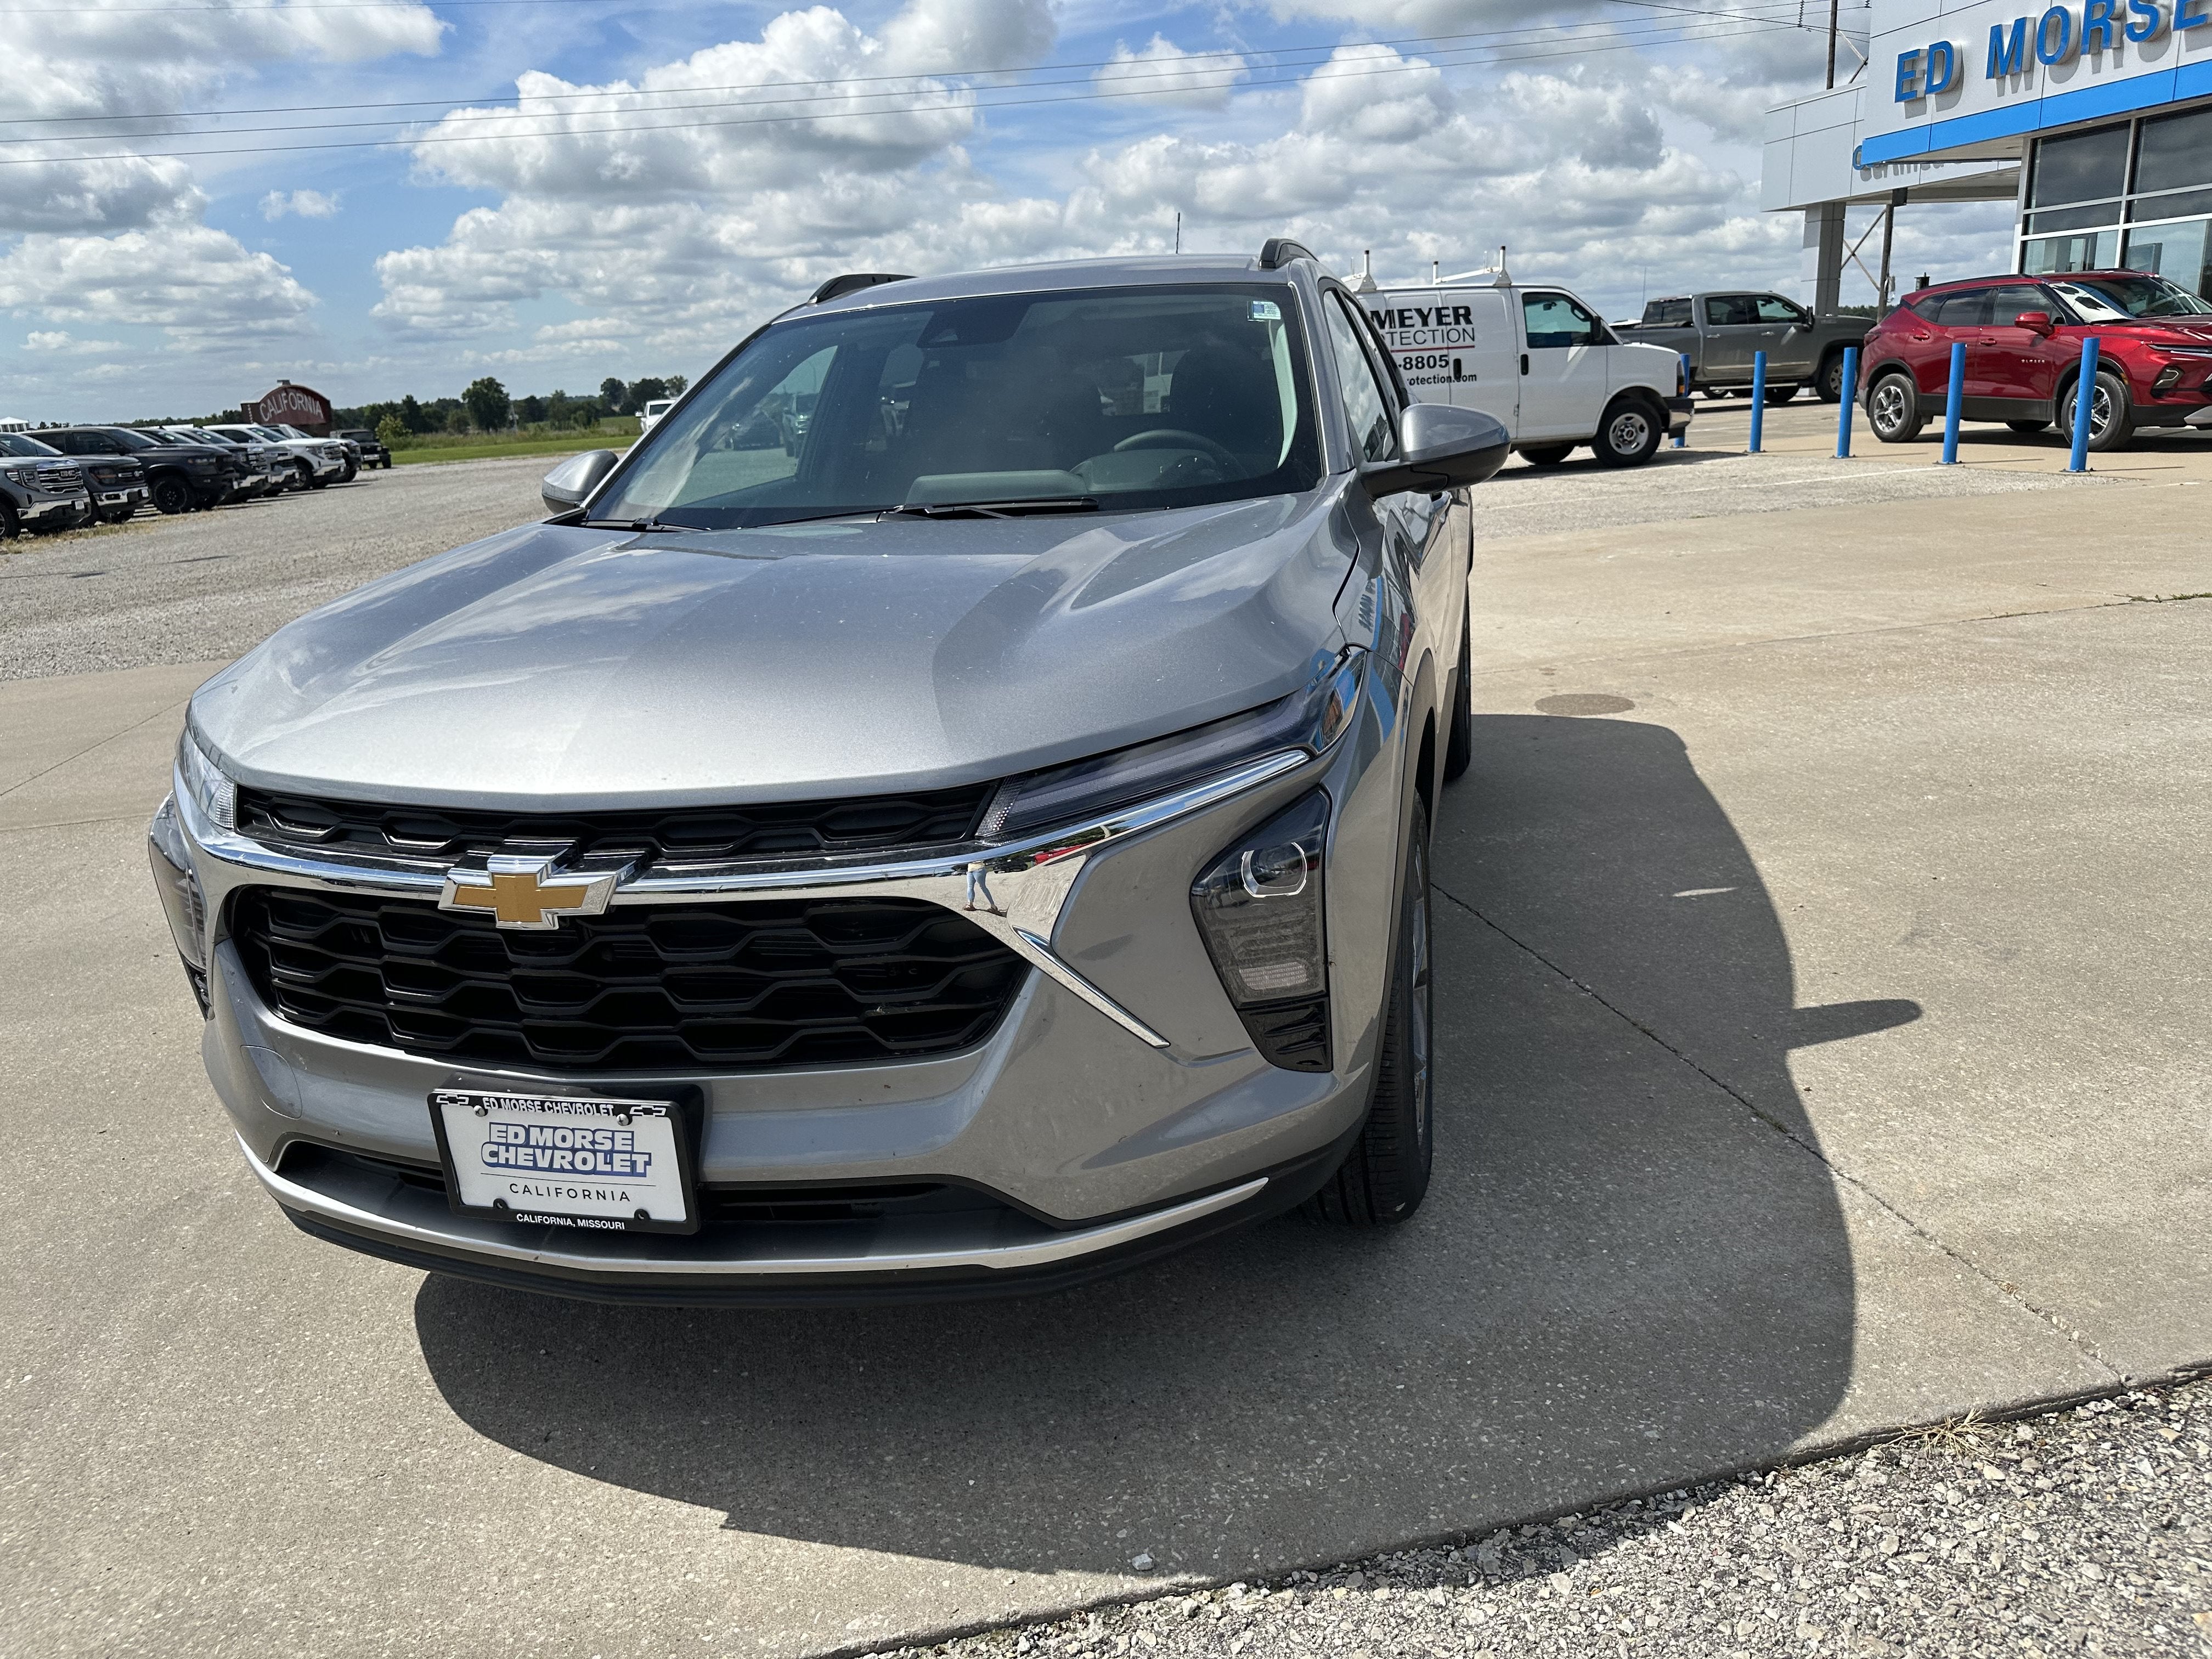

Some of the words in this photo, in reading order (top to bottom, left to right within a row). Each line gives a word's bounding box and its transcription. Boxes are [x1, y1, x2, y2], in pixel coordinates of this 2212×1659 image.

[1895, 40, 1956, 103] ED
[1370, 306, 1474, 330] MEYER
[1381, 328, 1476, 346] TECTION
[1407, 373, 1477, 386] otection.om
[259, 391, 325, 422] CALIFORNIA
[482, 1097, 498, 1110] ED
[500, 1098, 543, 1113] MORSE
[544, 1102, 614, 1116] CHEVROLET
[489, 1122, 527, 1146] ED
[528, 1125, 634, 1152] MORSE
[482, 1142, 651, 1176] CHEVROLET
[510, 1183, 630, 1201] CALIFORNIA
[516, 1213, 575, 1228] CALIFORNIA,
[578, 1218, 625, 1230] MISSOURI
